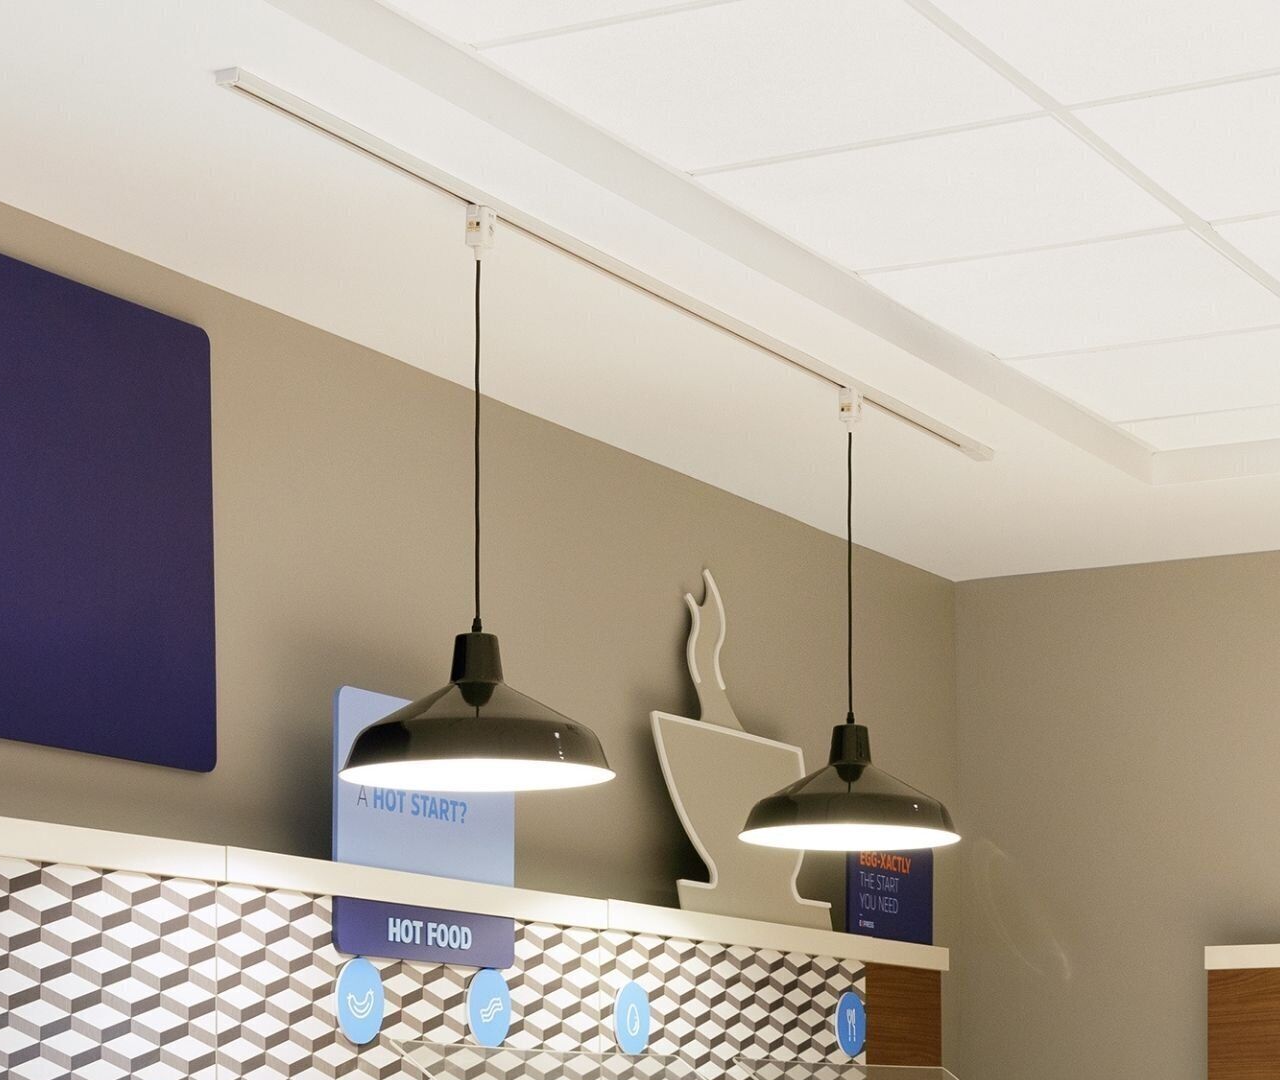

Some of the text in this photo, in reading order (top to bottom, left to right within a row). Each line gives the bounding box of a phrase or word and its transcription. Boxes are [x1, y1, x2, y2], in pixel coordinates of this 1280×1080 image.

[357, 785, 468, 824] A HOT START?
[860, 871, 900, 893] THE START
[859, 892, 899, 914] YOU NEED
[388, 917, 473, 950] HOT FOOD
